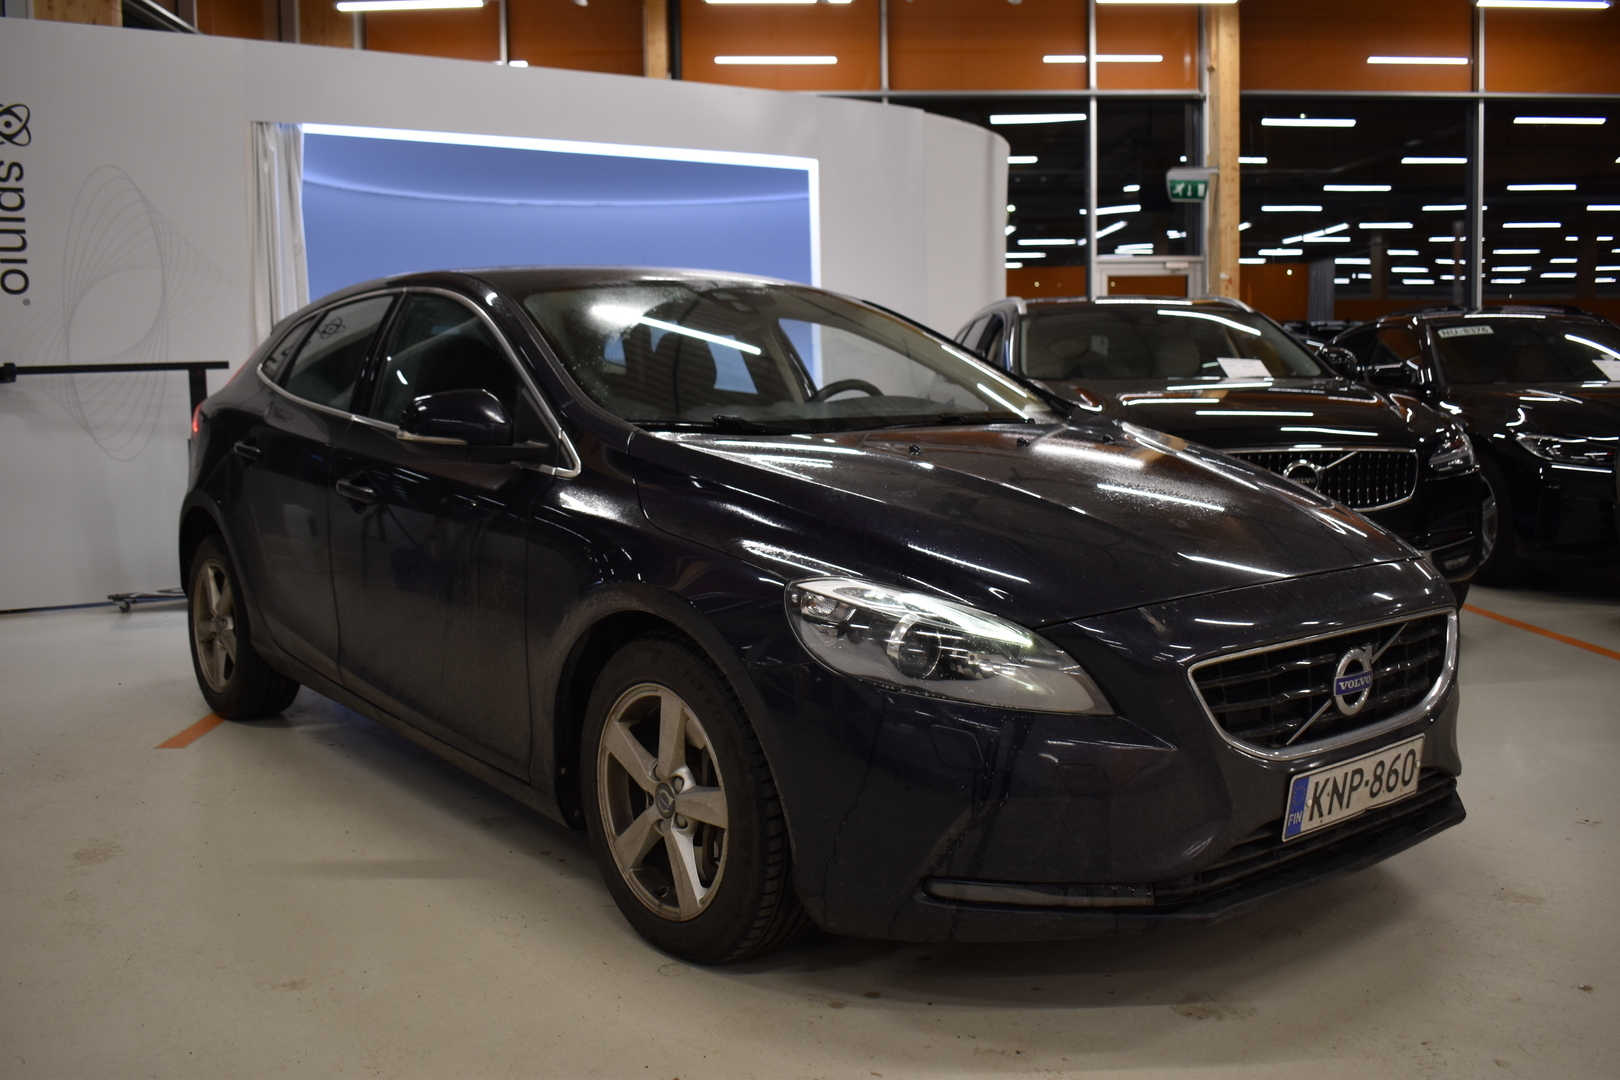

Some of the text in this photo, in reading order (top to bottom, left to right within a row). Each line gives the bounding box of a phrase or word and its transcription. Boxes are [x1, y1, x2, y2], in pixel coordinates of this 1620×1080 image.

[1339, 675, 1371, 691] VOLVO
[1308, 748, 1416, 822] KNP-860
[1287, 810, 1304, 827] FIN
